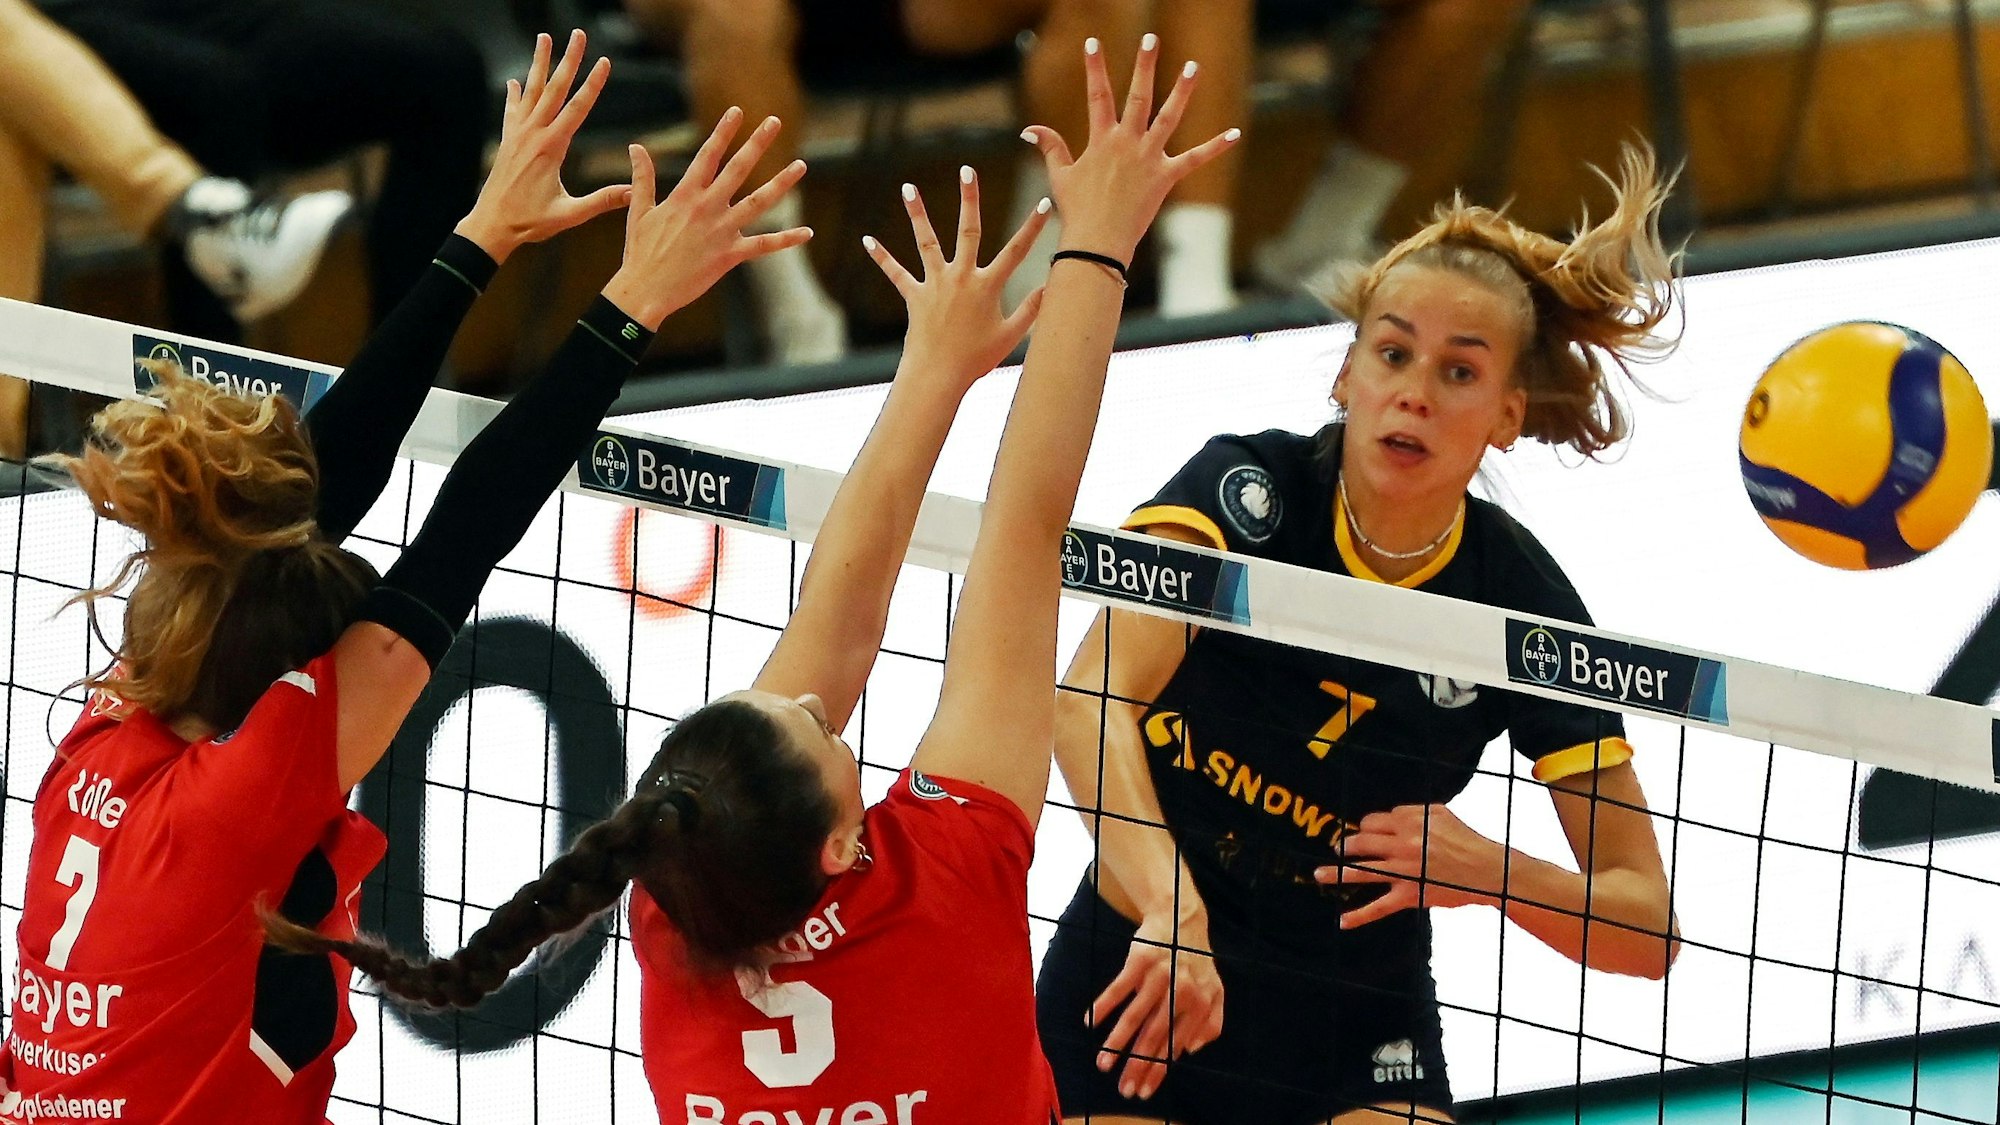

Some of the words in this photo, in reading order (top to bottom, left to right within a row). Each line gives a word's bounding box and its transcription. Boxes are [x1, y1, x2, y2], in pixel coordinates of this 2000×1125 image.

[595, 456, 626, 472] BAYER
[637, 448, 731, 506] Bayer
[1060, 553, 1085, 567] AYER
[1096, 543, 1193, 602] Bayer
[1525, 649, 1558, 665] BAYER
[1537, 633, 1548, 681] BAYER
[1570, 641, 1669, 702] Bayer
[1306, 680, 1377, 760] 7
[45, 834, 101, 972] 7
[12, 958, 124, 1034] ayer
[734, 948, 836, 1089] 5
[10, 1032, 107, 1077] everkuse
[686, 1090, 928, 1125] Ber
